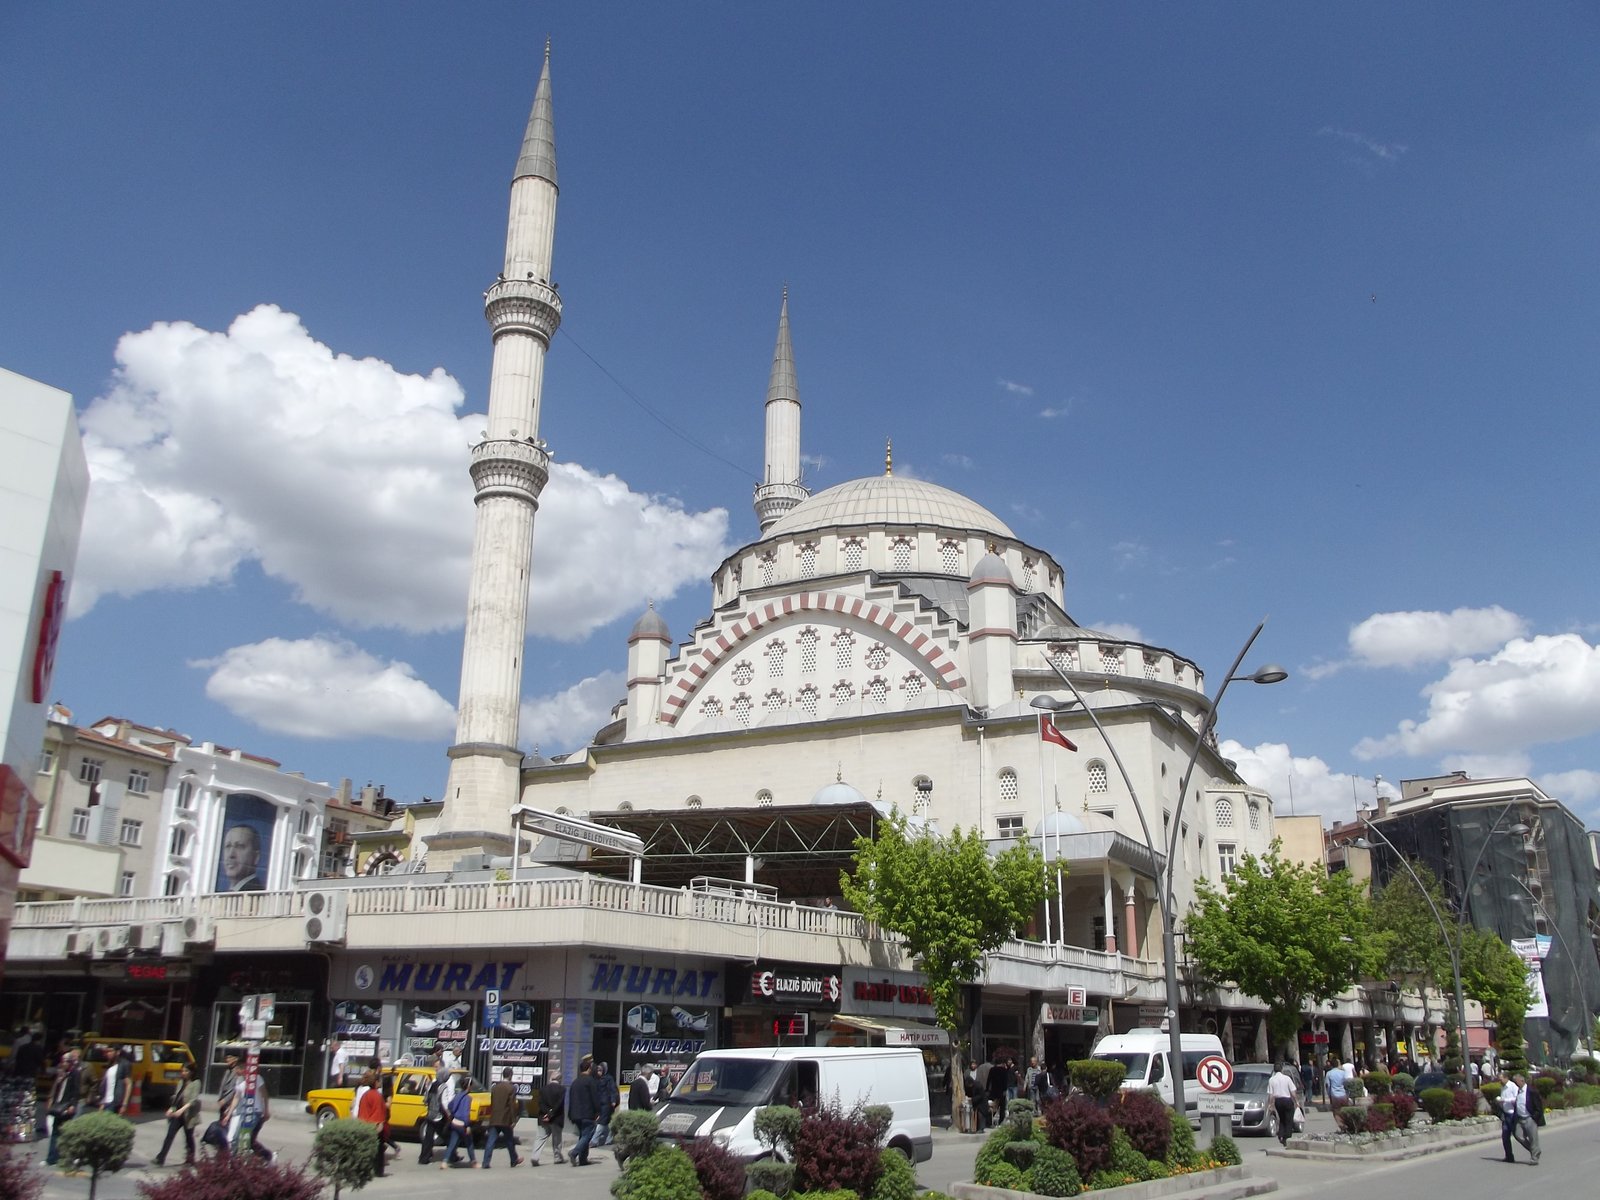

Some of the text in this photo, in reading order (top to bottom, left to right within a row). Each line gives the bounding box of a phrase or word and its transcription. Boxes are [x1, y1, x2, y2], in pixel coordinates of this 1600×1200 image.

[379, 962, 526, 991] MURAT
[591, 962, 719, 998] MURAT
[801, 977, 822, 993] DÖVİZ
[854, 979, 898, 1002] HATİP
[488, 992, 497, 1004] D
[1072, 991, 1081, 1003] E
[1046, 1007, 1080, 1020] ECZANE
[336, 1023, 381, 1034] MURAT
[900, 1032, 939, 1041] HATİP USTA
[480, 1038, 545, 1051] MURAT
[631, 1039, 706, 1053] MURAT
